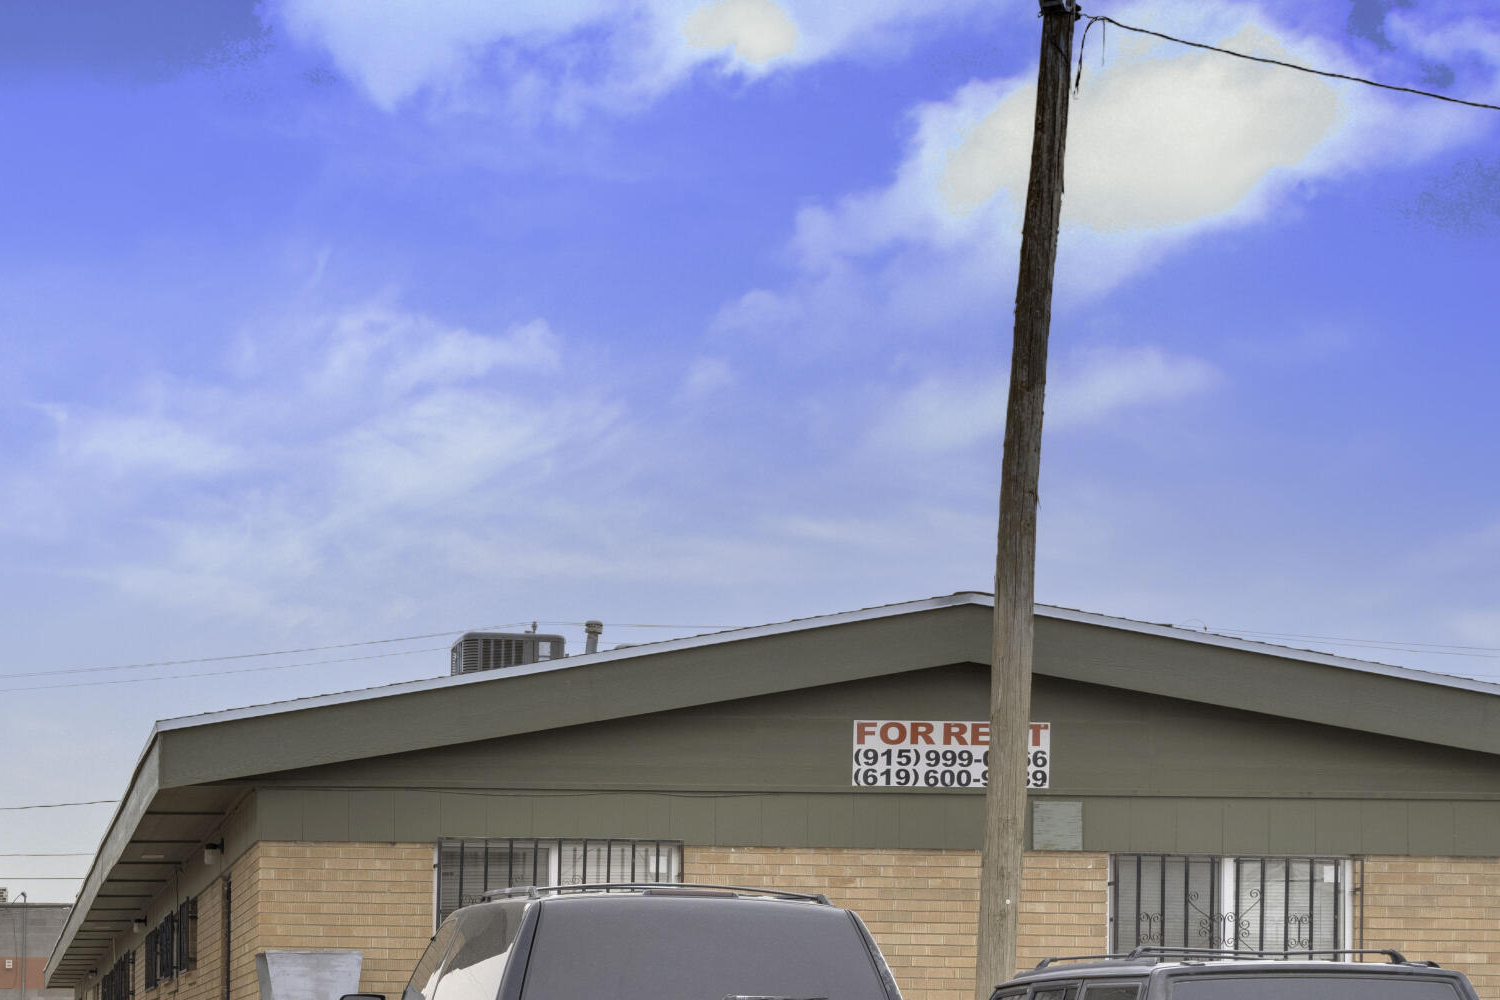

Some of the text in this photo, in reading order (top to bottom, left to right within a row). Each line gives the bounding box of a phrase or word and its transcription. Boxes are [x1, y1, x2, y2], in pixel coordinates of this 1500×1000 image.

[856, 722, 1049, 747] FOR RET
[854, 748, 921, 767] (915)
[853, 768, 920, 786] (619)
